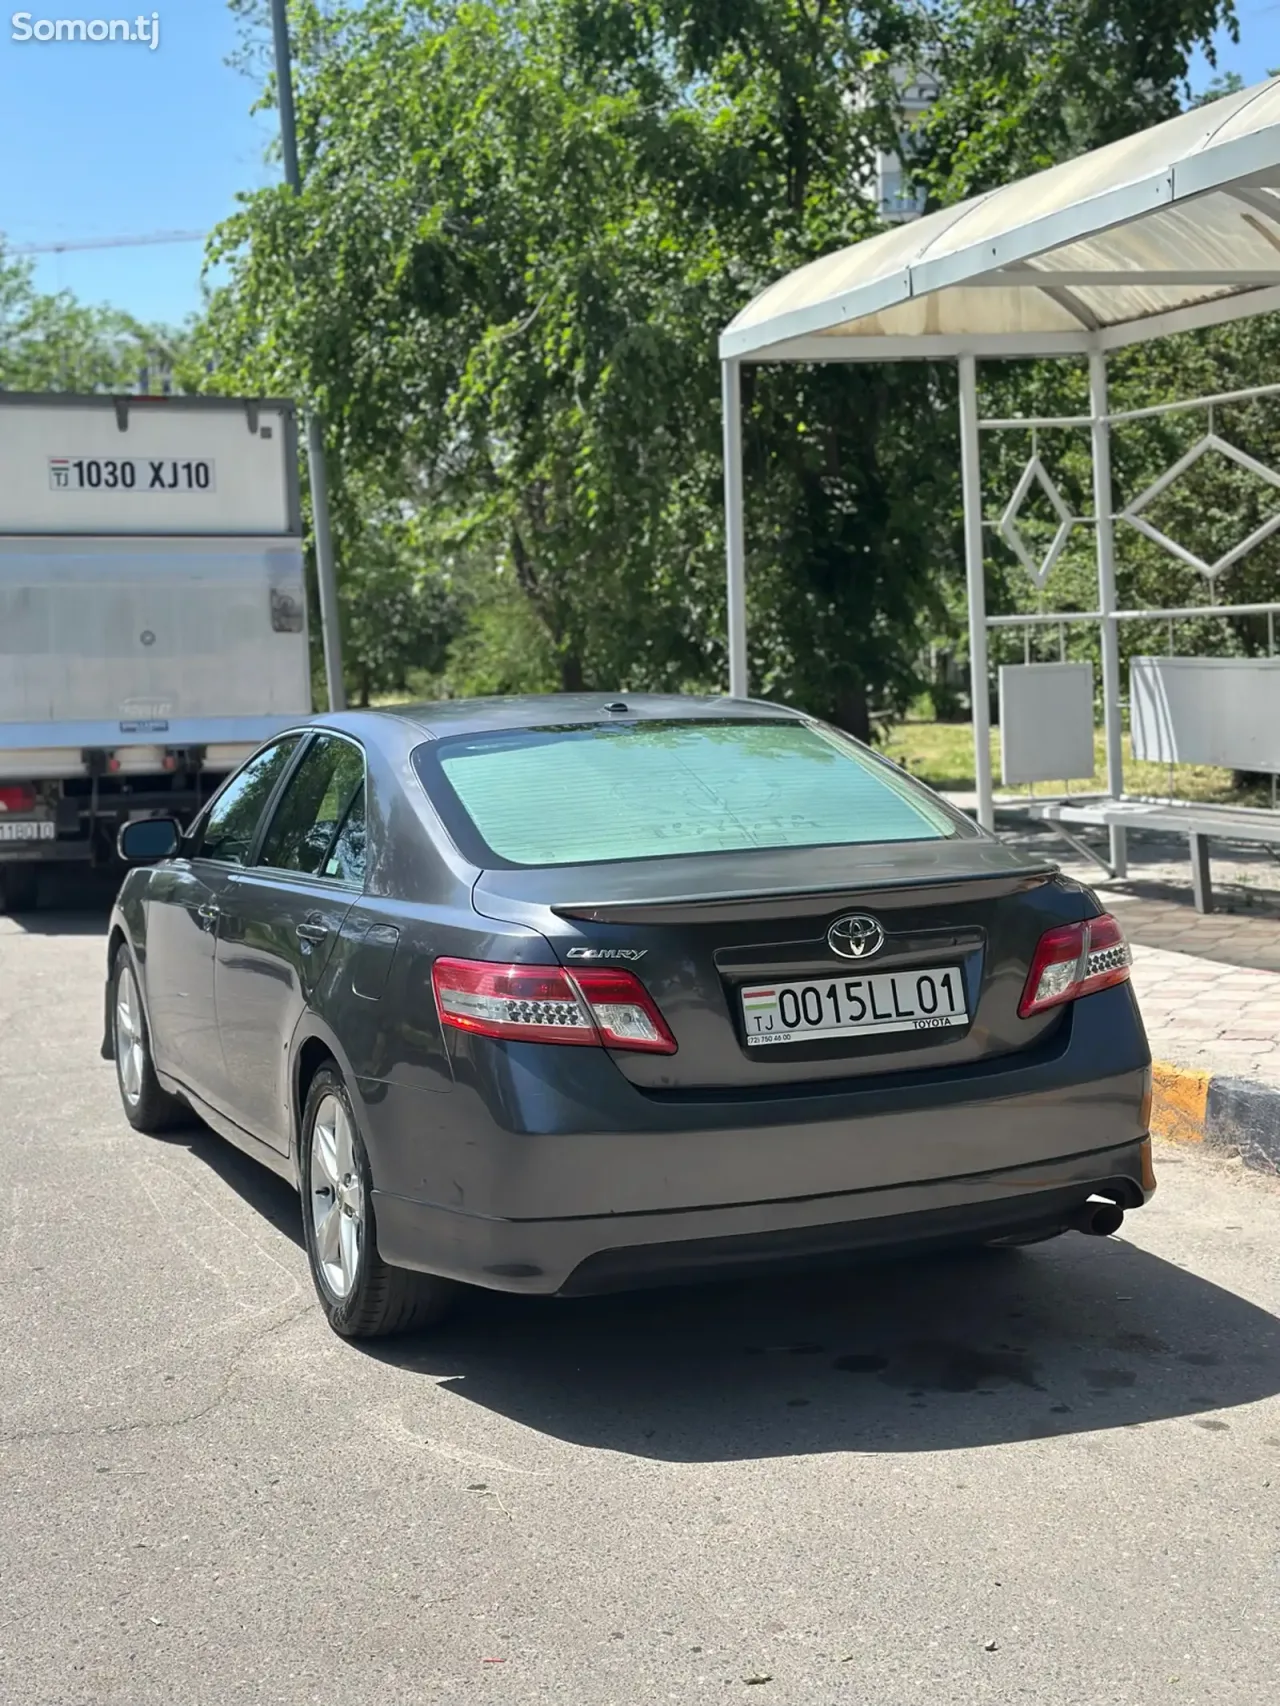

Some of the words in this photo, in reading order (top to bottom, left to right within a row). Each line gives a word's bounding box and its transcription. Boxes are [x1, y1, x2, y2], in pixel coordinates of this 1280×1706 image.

[54, 472, 69, 488] TJ
[73, 460, 136, 489] 1030
[148, 461, 210, 489] XJ10
[779, 973, 956, 1028] 0015LL01
[753, 1014, 774, 1031] TJ
[912, 1017, 952, 1029] TOYOTA
[783, 1033, 791, 1041] 00
